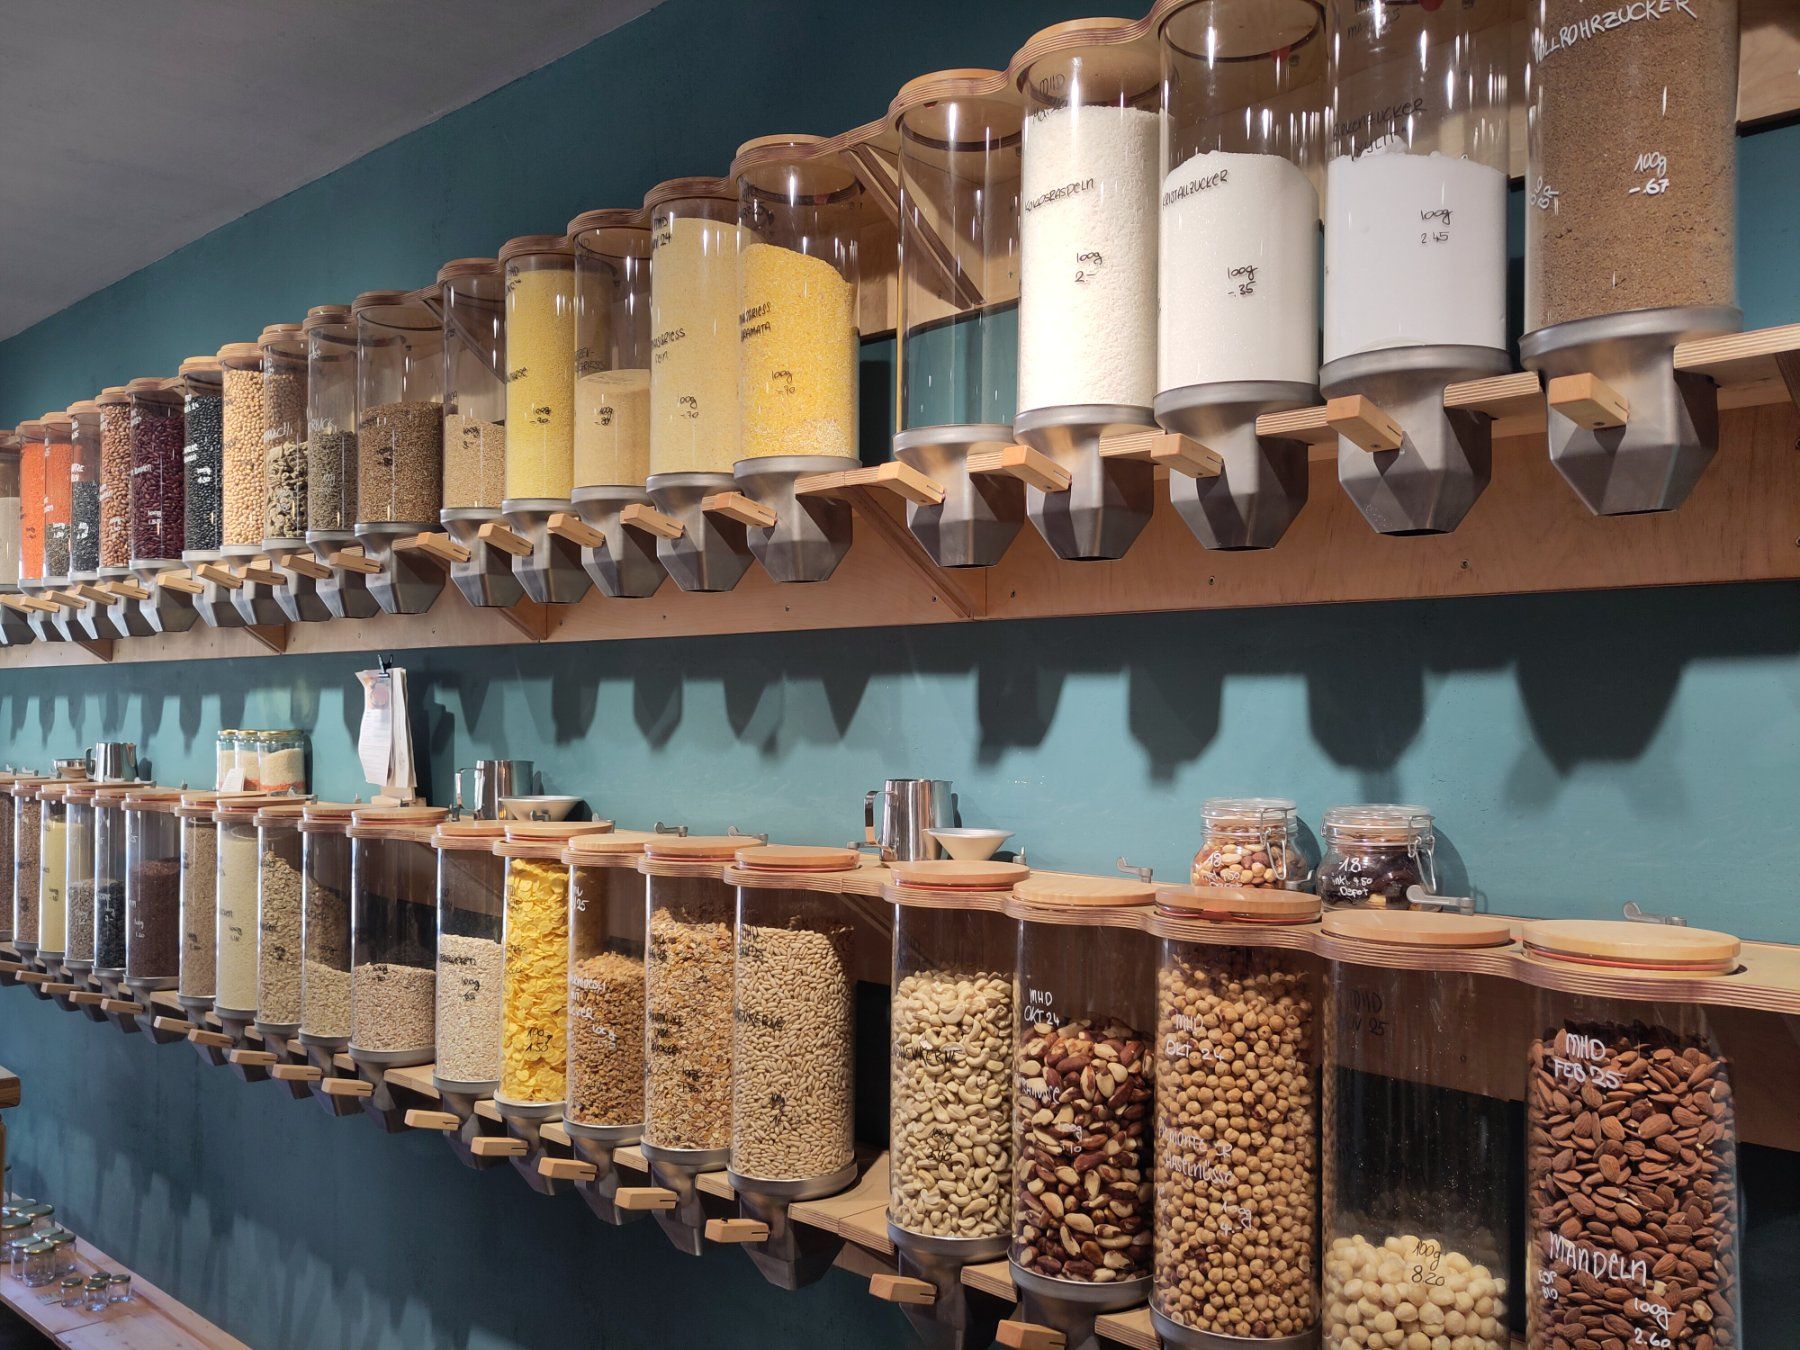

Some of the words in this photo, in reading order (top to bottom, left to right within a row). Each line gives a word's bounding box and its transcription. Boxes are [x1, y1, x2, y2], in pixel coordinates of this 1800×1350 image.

[1634, 152, 1668, 178] 100g
[1024, 177, 1095, 215] KOKOSRASPELN
[1161, 168, 1229, 212] KRISTALLZUCKER
[1420, 206, 1454, 225] 100g
[1075, 251, 1104, 267] 100g
[1227, 265, 1260, 281] 100g
[772, 369, 793, 384] 100g
[680, 395, 698, 409] 00g
[1029, 988, 1053, 1007] MHD
[1024, 1005, 1044, 1026] OKT
[1046, 1011, 1060, 1027] 24
[1166, 1041, 1192, 1059] OKT
[1201, 1047, 1225, 1061] 24
[1565, 1033, 1607, 1061] MHD
[1554, 1059, 1586, 1083] FEB
[1591, 1066, 1628, 1090] 25
[1413, 1239, 1441, 1271] 100g
[1549, 1232, 1648, 1288] MANDELN
[1634, 1297, 1677, 1331] 100g
[1634, 1327, 1671, 1349] 2.60
